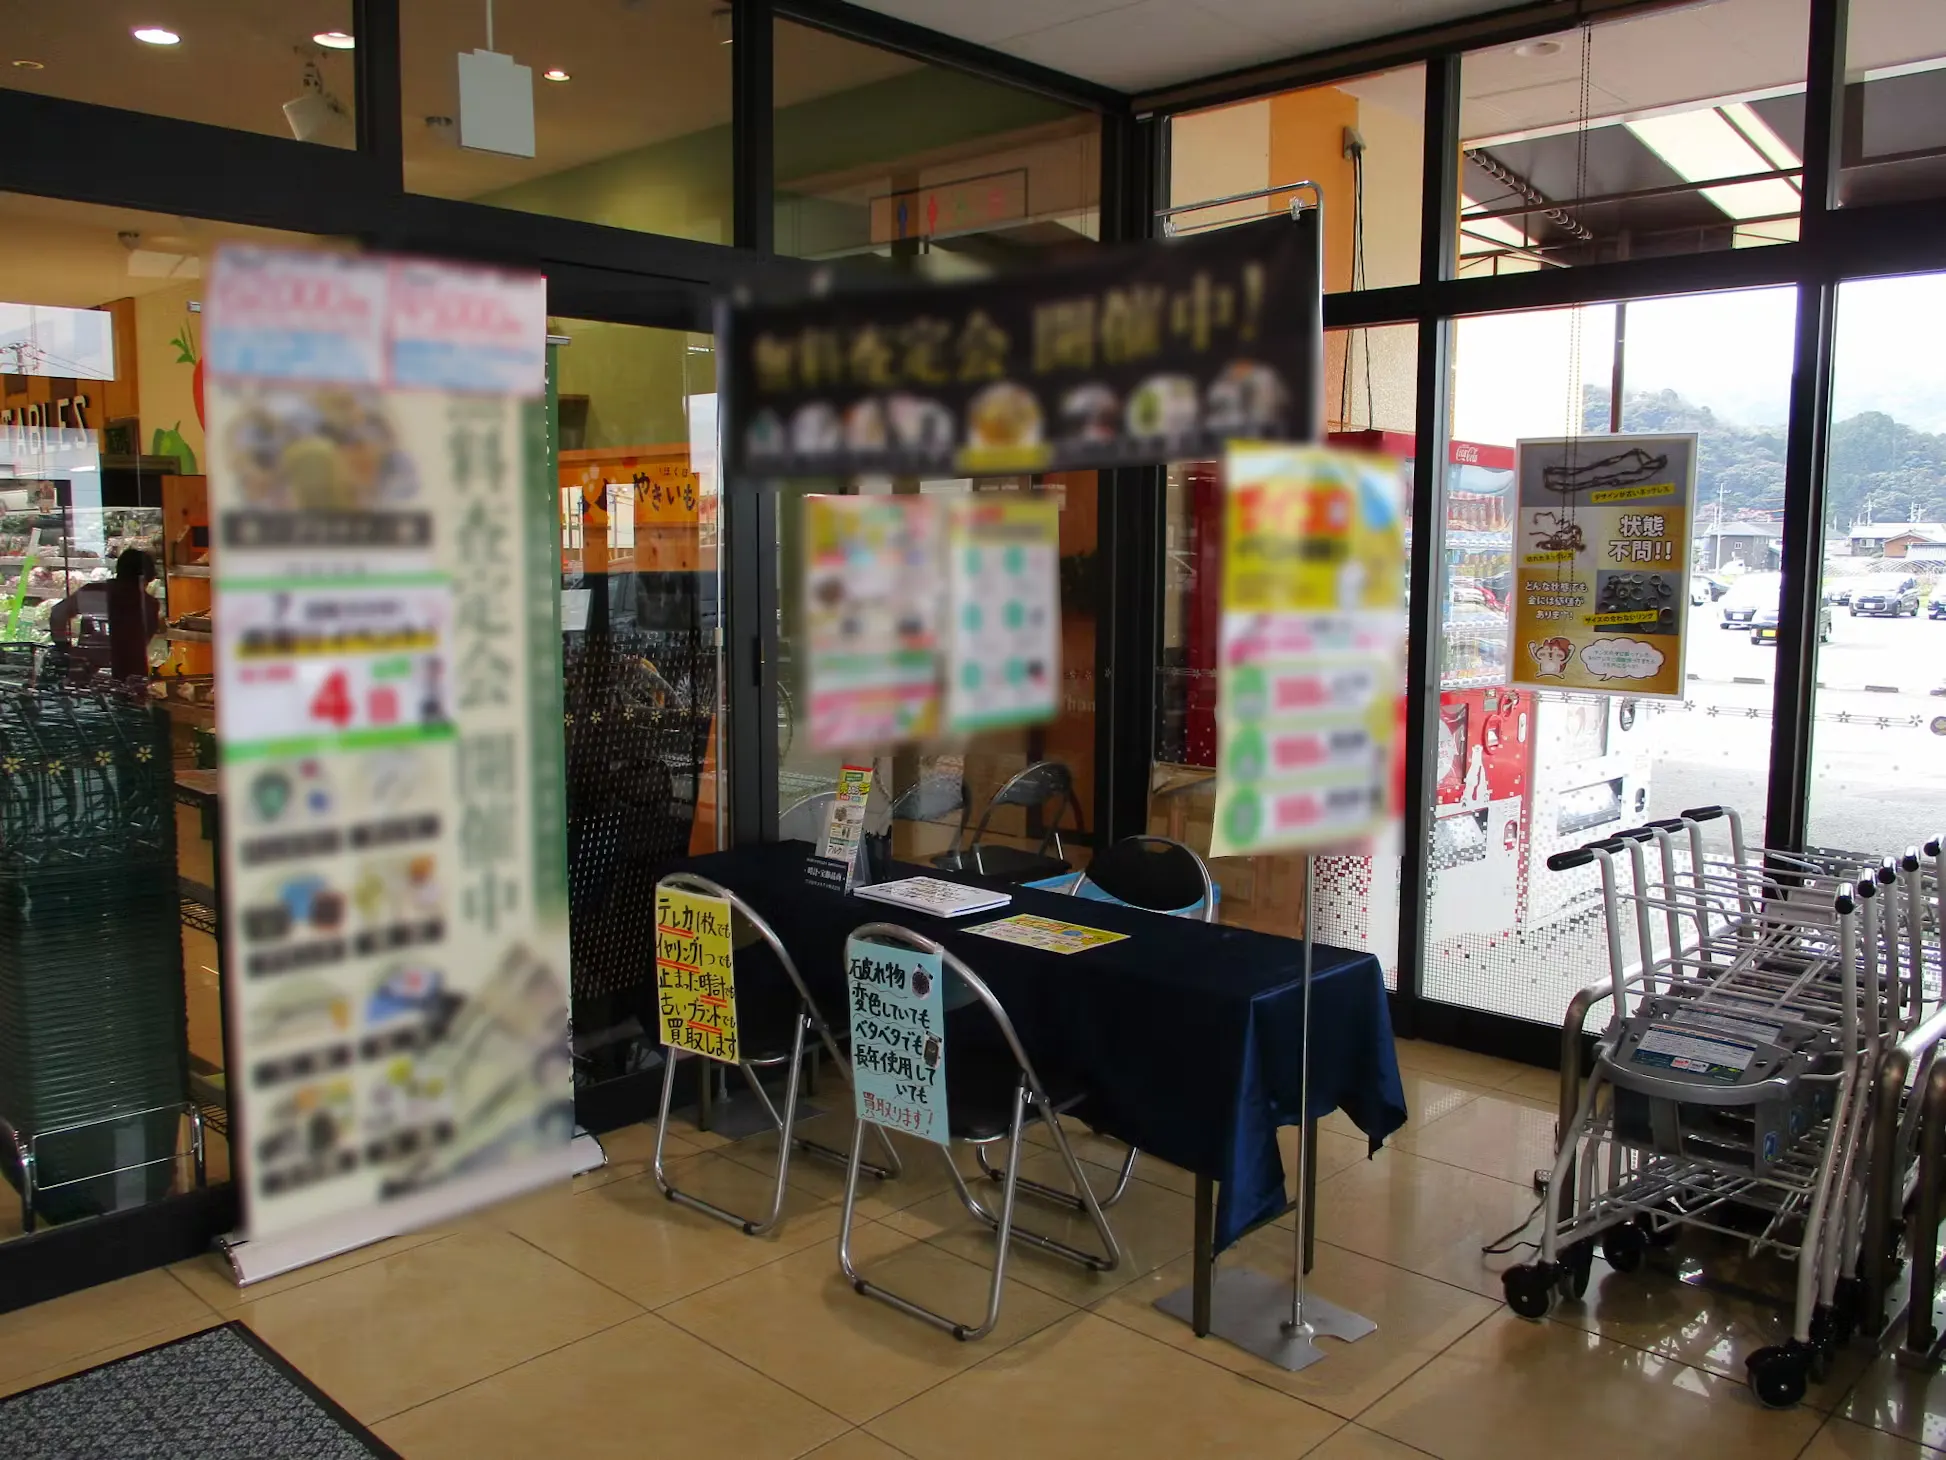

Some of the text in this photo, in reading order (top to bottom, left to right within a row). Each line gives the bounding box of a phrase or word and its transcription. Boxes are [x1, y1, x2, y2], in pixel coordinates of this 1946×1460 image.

[632, 471, 696, 511] やきいも
[1619, 513, 1664, 538] 状態
[1524, 581, 1589, 593] どんな状態でも
[1584, 611, 1655, 625] サイズの合わないリング
[659, 968, 736, 1000] 止まった時計でも
[660, 992, 736, 1029] 古いブランドでも
[851, 982, 930, 1029] 変色していても
[667, 1017, 737, 1061] 買取します
[855, 1019, 923, 1056] ベタベタでも
[854, 1043, 936, 1086] 長年使用して
[896, 1083, 928, 1104] いても
